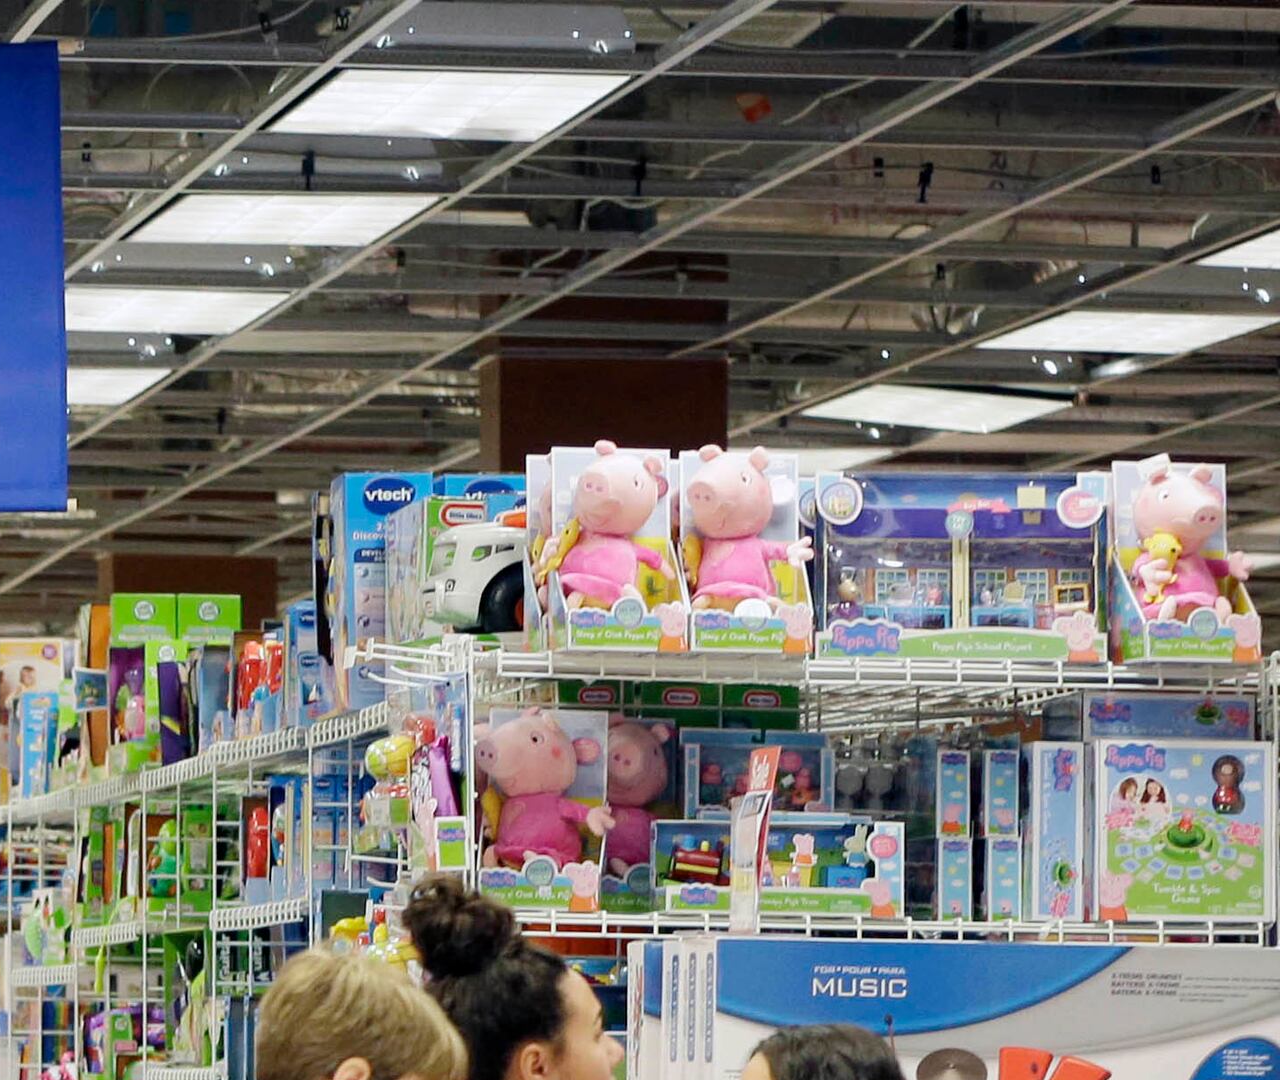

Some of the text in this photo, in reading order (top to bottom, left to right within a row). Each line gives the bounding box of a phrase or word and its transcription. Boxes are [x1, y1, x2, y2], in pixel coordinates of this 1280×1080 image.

[365, 488, 414, 502] vtech
[832, 627, 875, 650] Peppa
[812, 977, 908, 998] MUSIC
